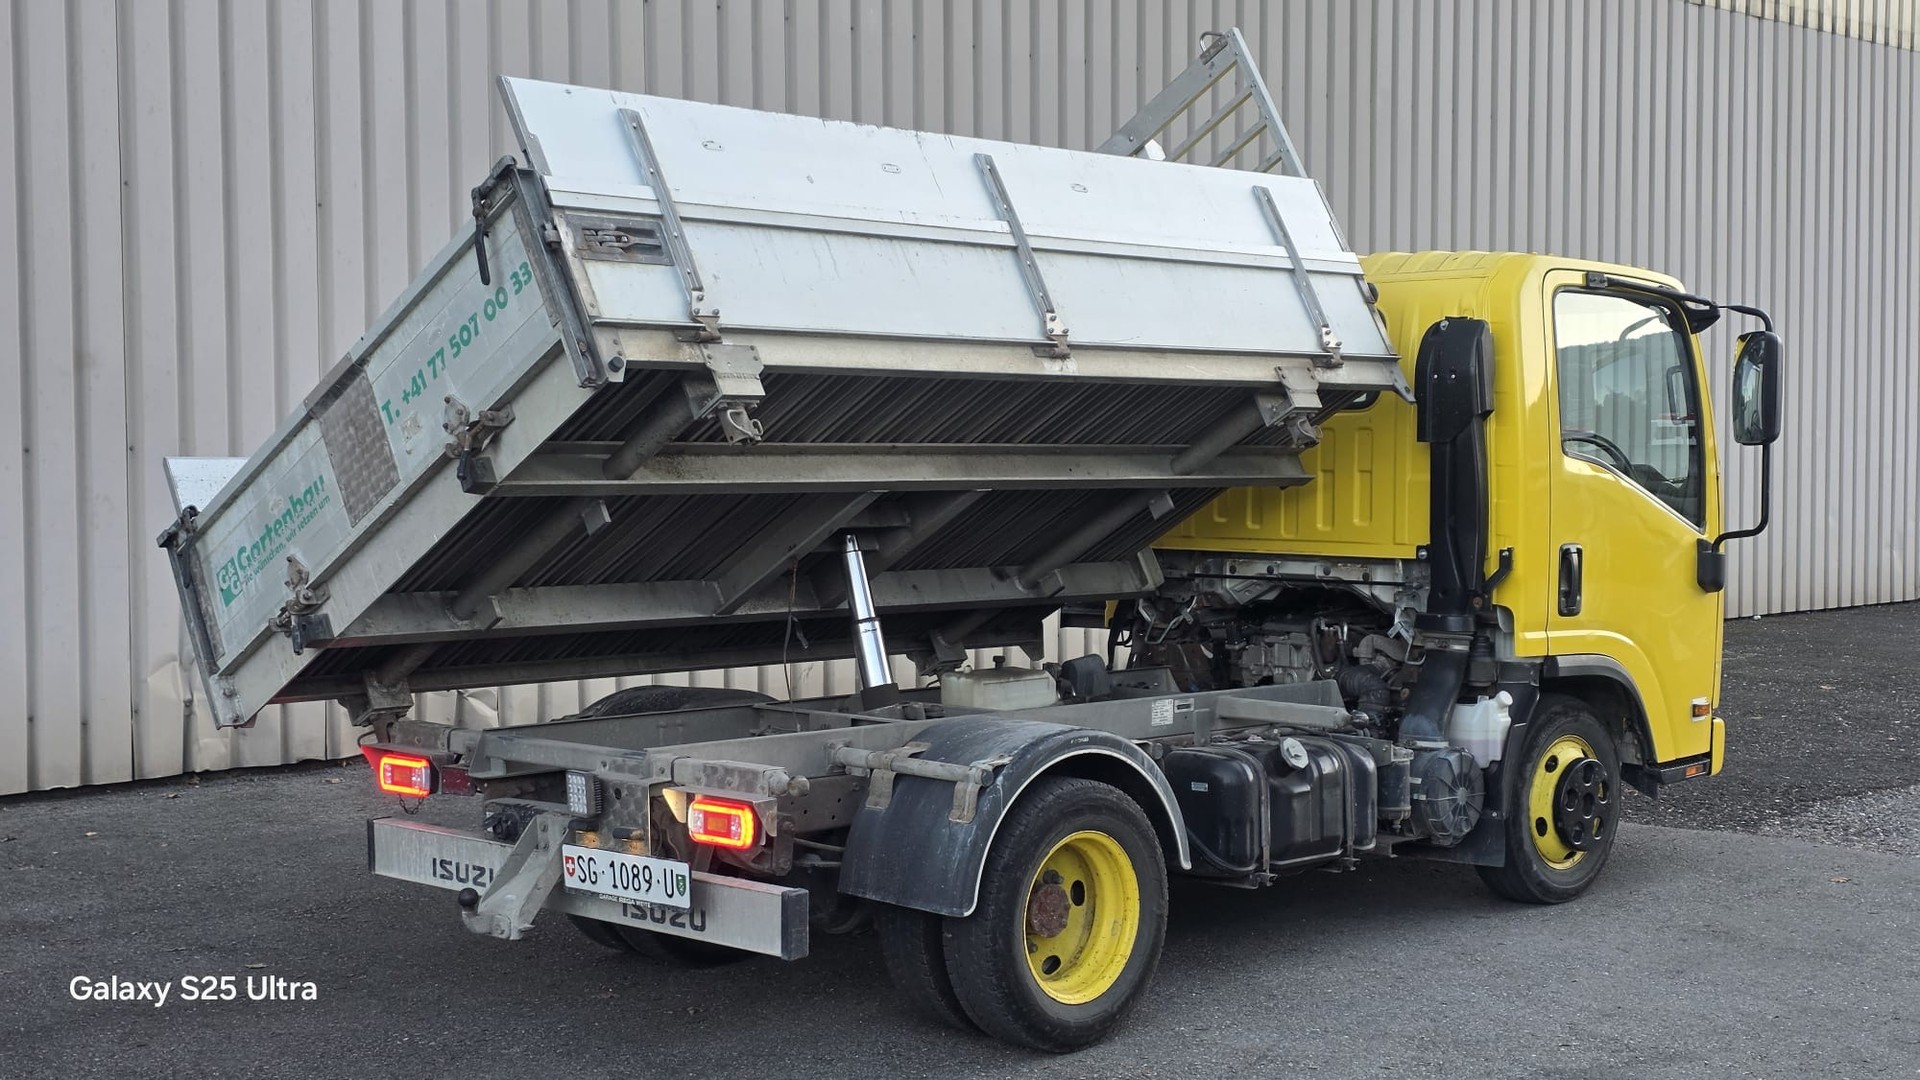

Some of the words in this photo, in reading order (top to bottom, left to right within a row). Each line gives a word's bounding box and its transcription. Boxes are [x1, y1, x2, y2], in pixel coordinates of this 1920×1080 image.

[381, 399, 400, 425] T.
[402, 369, 428, 404] +41
[427, 347, 446, 380] 77
[448, 312, 479, 359] 507
[483, 286, 509, 321] 00
[510, 261, 533, 295] 33
[236, 474, 325, 572] Gartenbau
